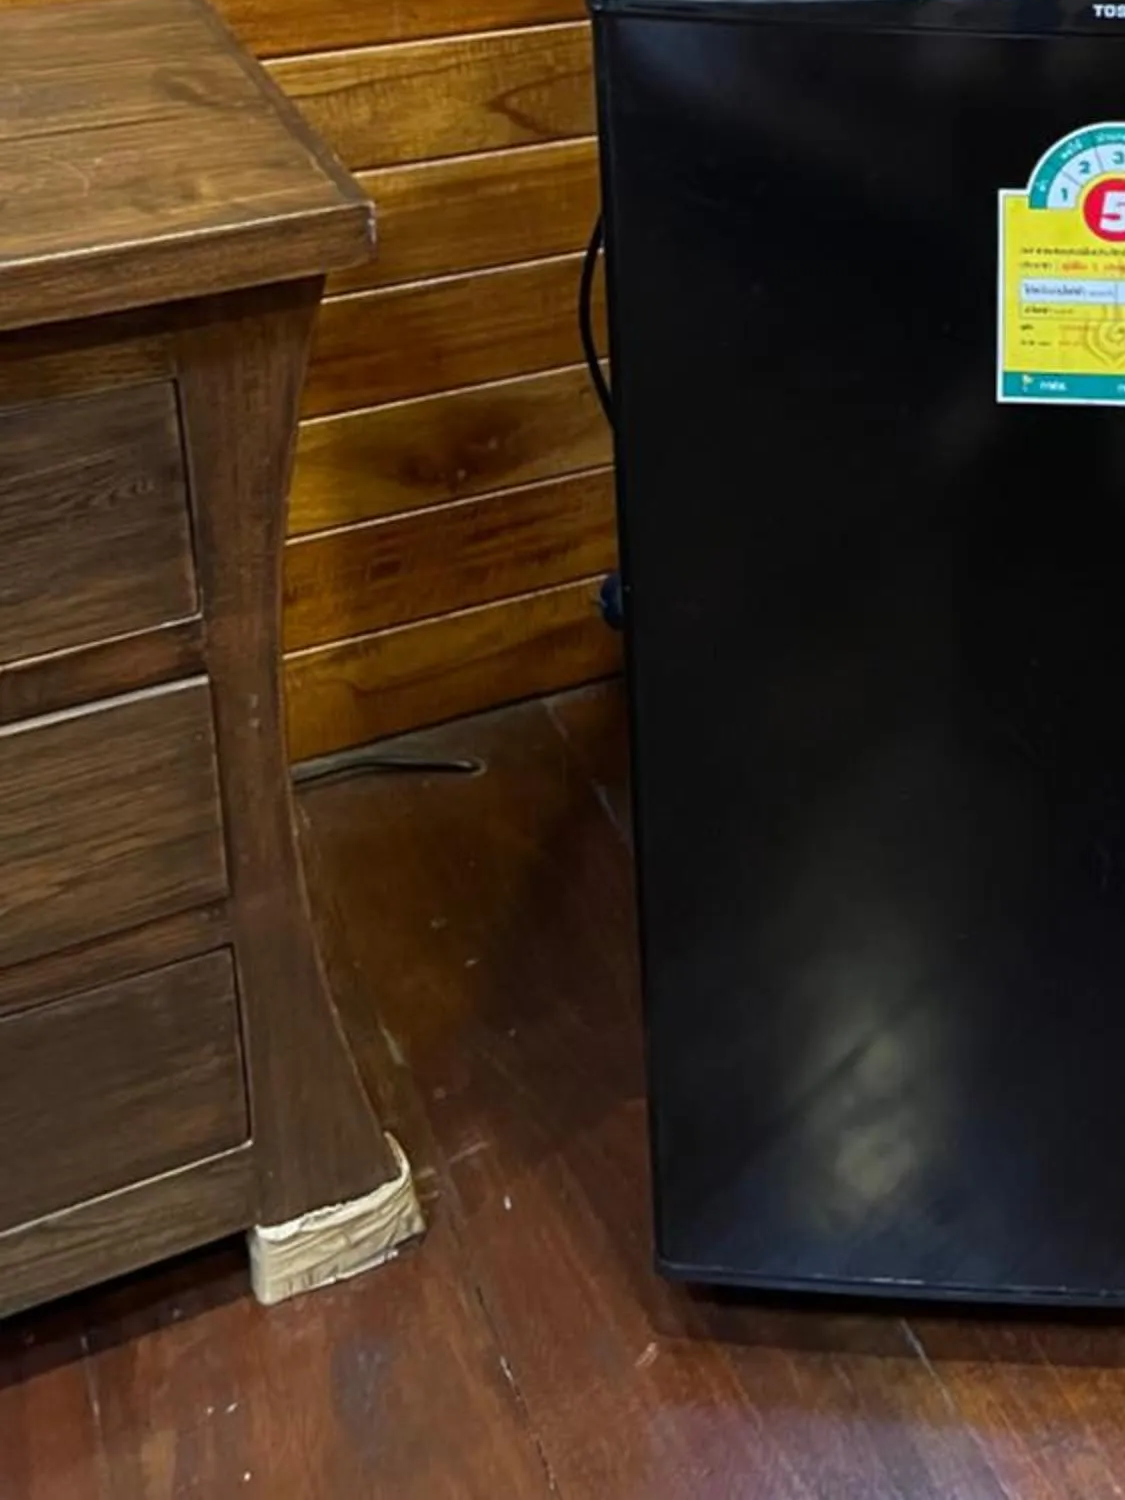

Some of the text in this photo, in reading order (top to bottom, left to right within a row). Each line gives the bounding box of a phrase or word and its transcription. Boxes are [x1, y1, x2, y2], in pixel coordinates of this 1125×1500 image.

[1112, 150, 1125, 165] 3
[1078, 161, 1091, 175] 2
[1061, 187, 1068, 201] 1
